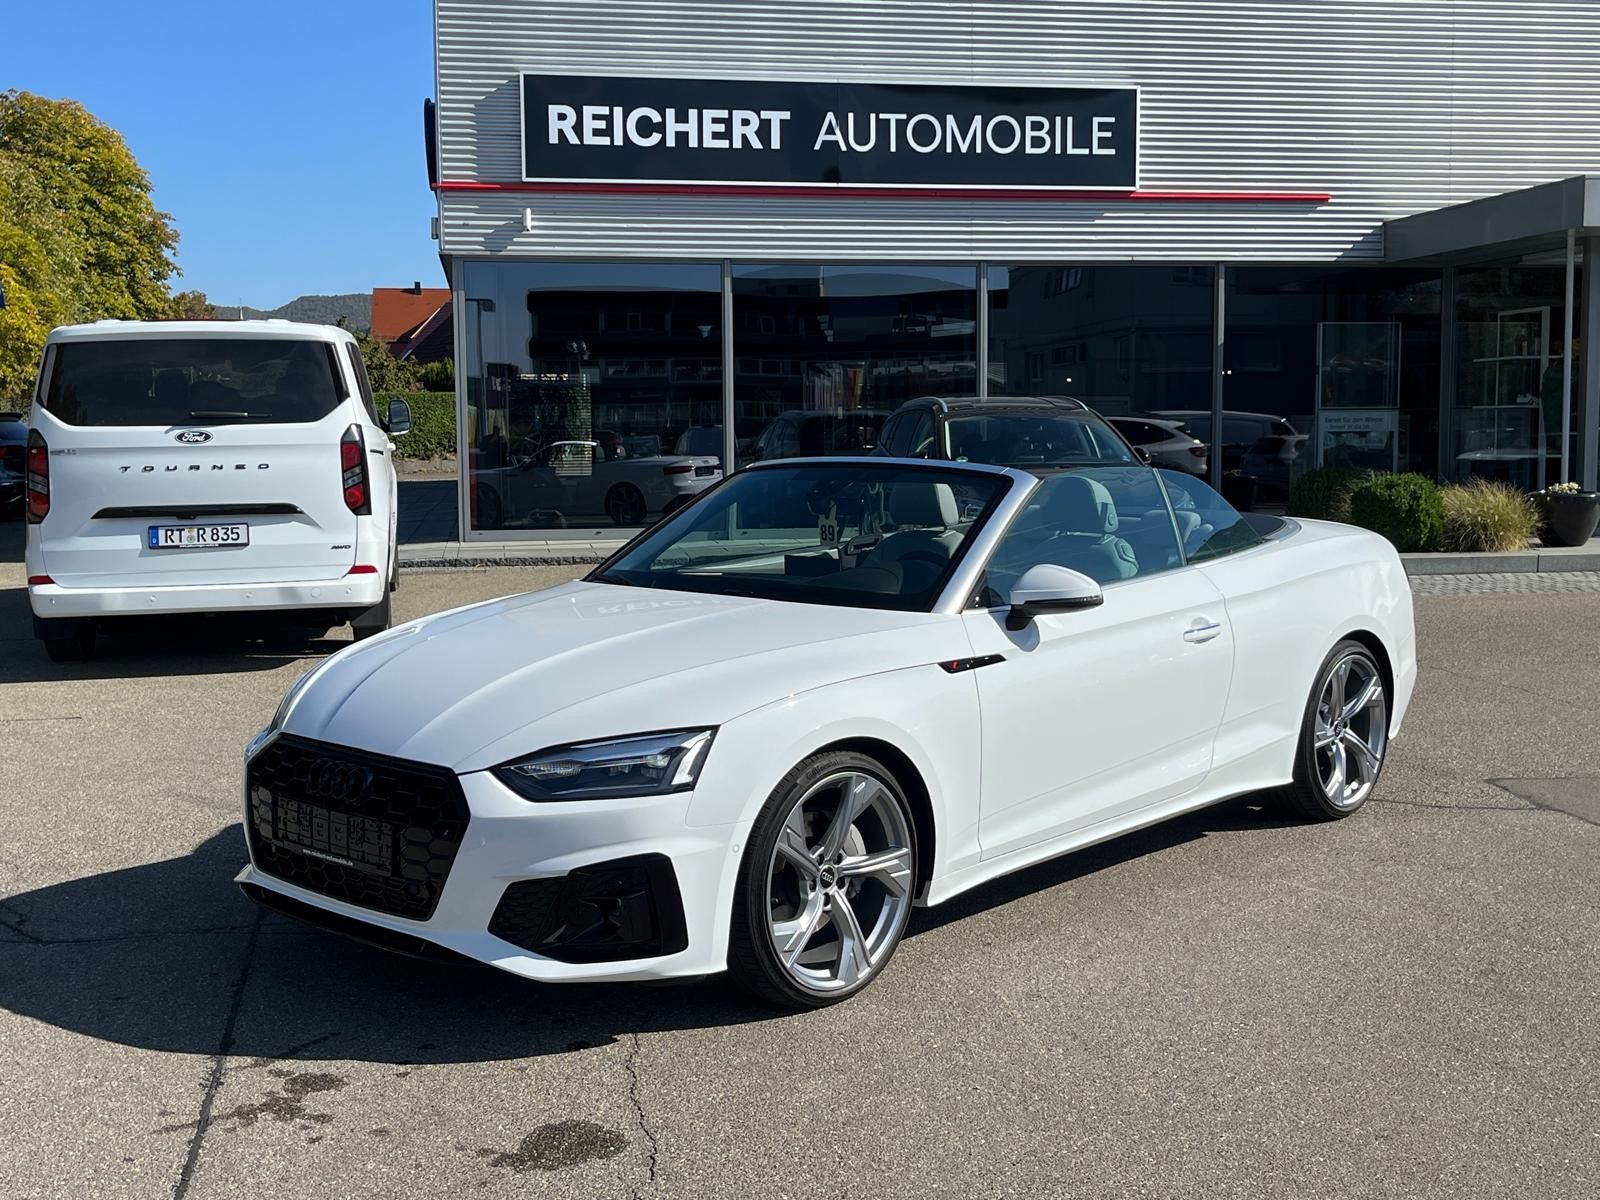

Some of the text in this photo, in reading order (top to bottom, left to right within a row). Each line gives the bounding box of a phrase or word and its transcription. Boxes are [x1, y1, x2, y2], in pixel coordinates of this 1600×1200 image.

[548, 104, 1116, 155] REICHERT AUTOMOBILE
[120, 464, 270, 473] TOURNEO
[165, 526, 240, 543] RT R 835
[820, 525, 834, 541] 89
